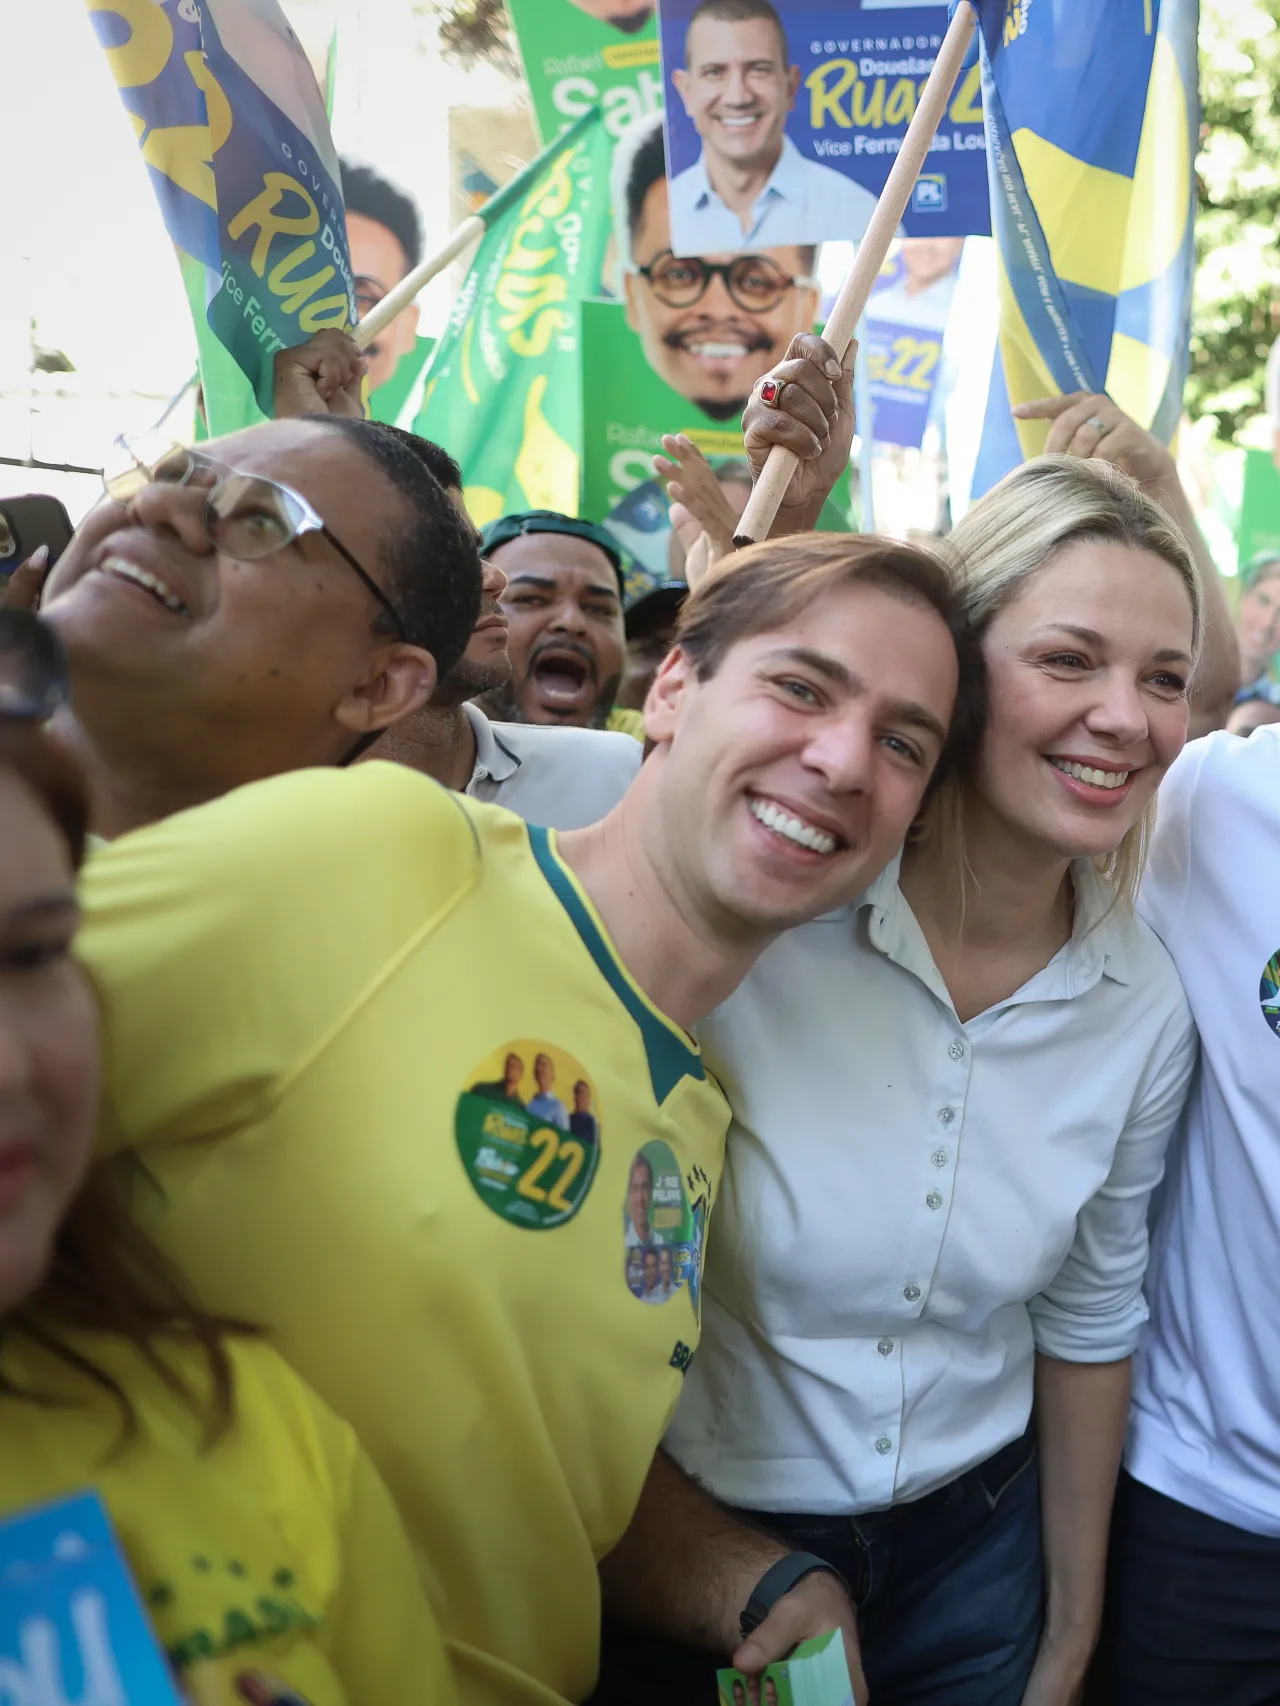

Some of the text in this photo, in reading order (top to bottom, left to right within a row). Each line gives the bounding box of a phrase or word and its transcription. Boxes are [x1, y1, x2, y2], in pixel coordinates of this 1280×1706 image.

[810, 34, 942, 54] GOVERNADOR
[552, 70, 664, 138] Sat
[813, 138, 853, 157] Vice
[854, 133, 952, 156] Ferna
[917, 180, 943, 202] PL
[227, 171, 353, 334] Rua
[243, 296, 289, 352] Fern
[516, 1128, 586, 1212] 22
[669, 1340, 695, 1377] BRA
